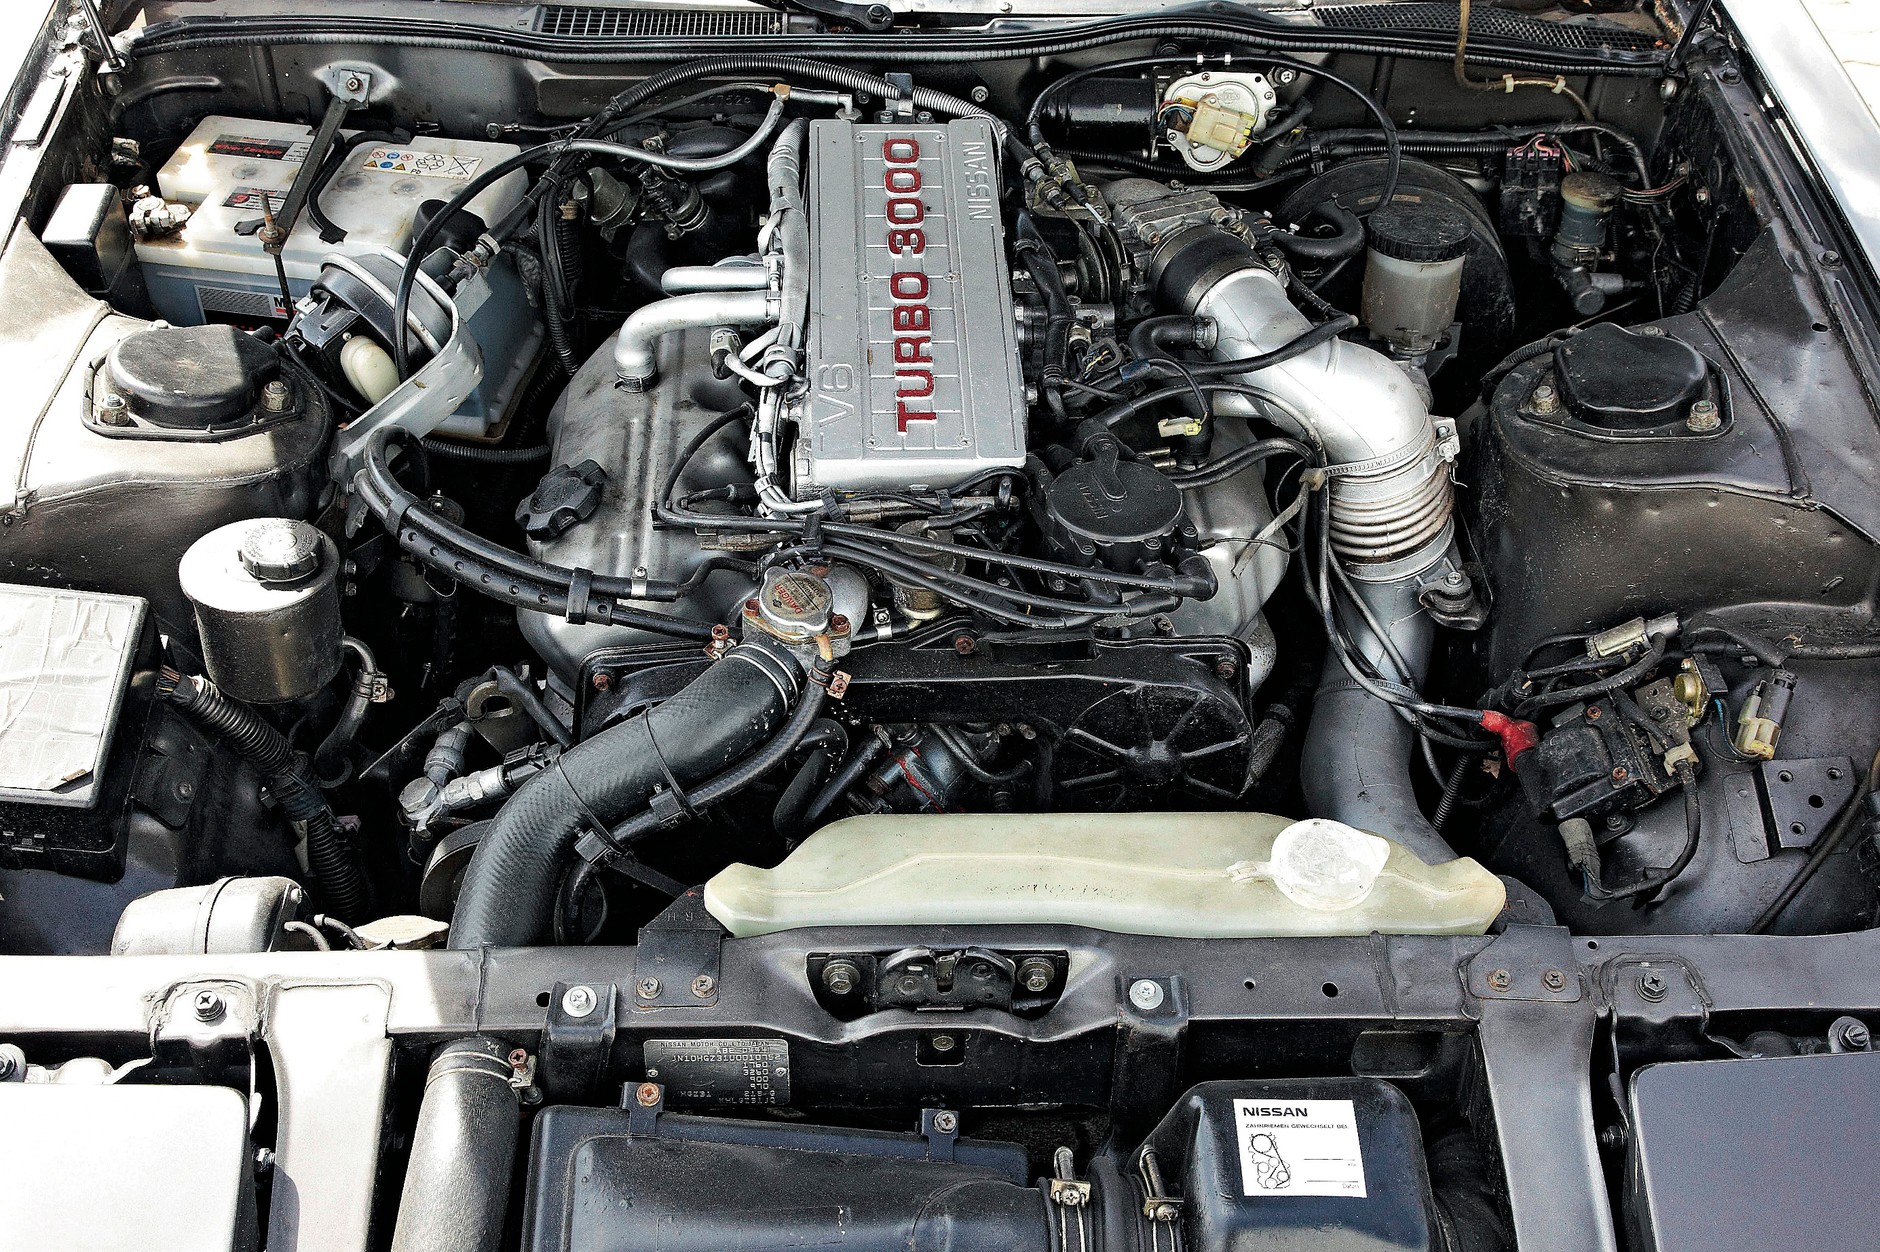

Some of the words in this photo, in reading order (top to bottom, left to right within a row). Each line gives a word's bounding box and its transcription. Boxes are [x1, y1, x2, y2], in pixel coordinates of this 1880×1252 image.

[882, 137, 927, 258] 3000
[962, 141, 993, 220] NISSAN
[888, 271, 938, 436] TURBO
[817, 362, 855, 429] V6
[774, 583, 804, 614] DANGER
[749, 1075, 769, 1083] 900
[1243, 1107, 1308, 1117] NISSAN
